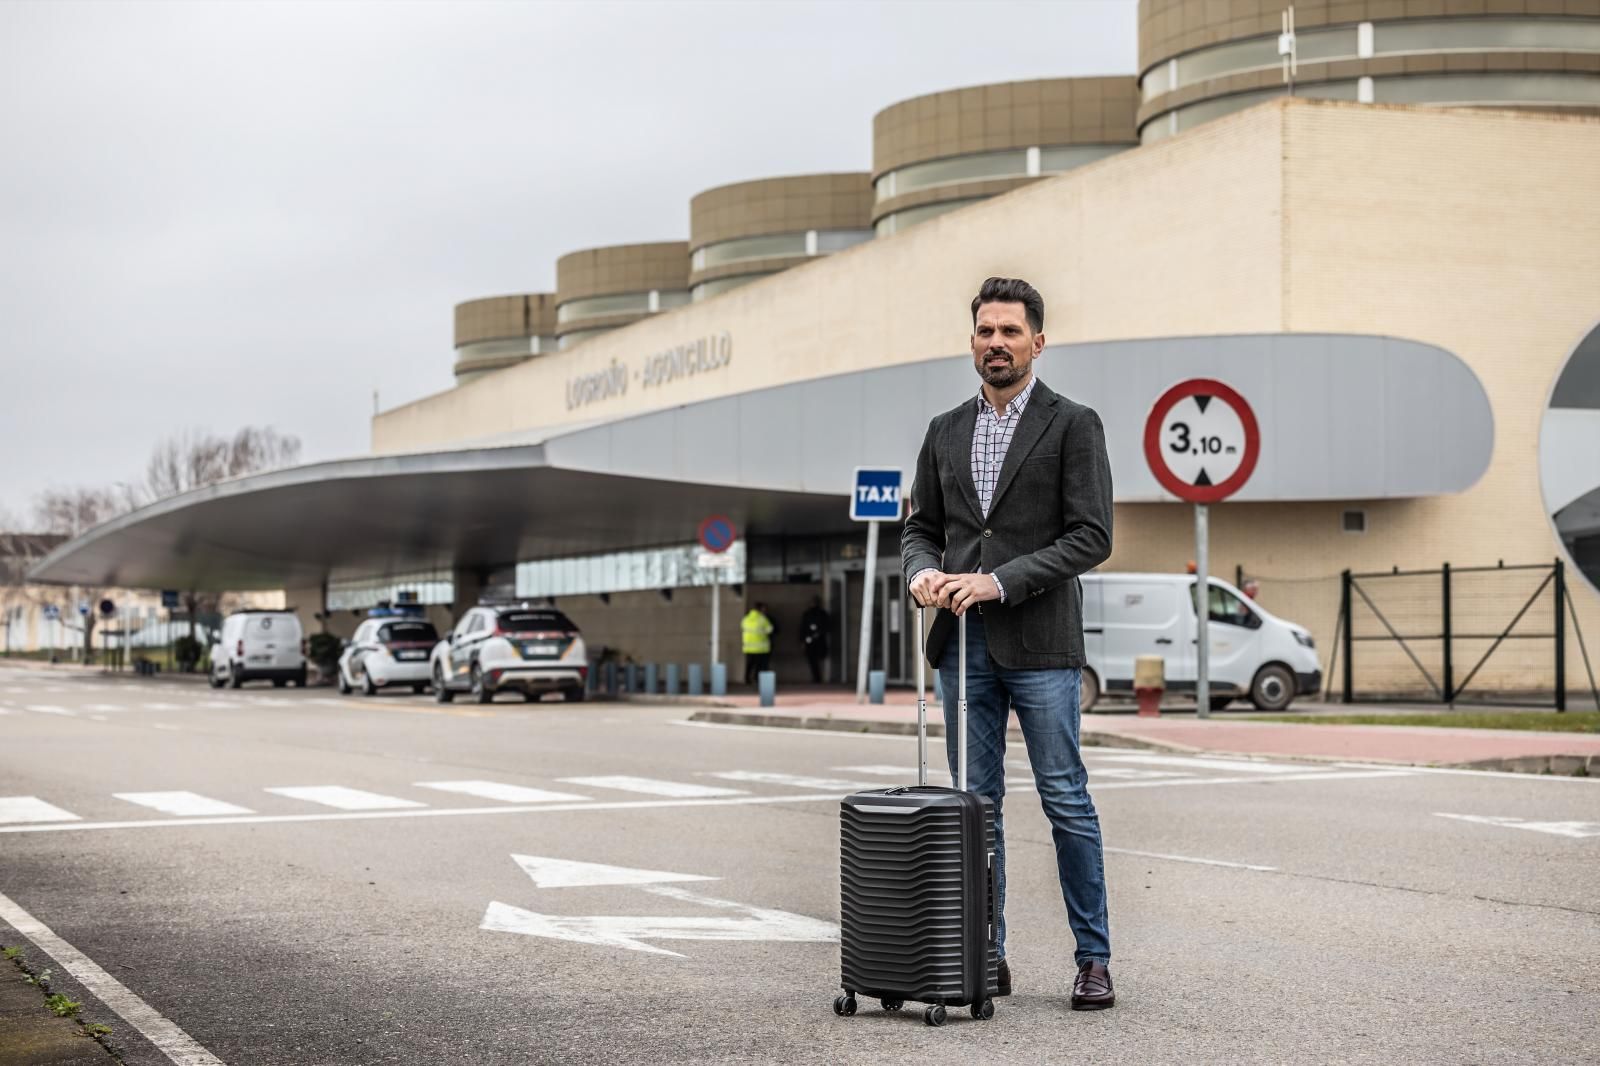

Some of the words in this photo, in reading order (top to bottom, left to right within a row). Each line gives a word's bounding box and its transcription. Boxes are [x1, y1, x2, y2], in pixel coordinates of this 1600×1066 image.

[565, 357, 628, 411] LOGROÑO
[642, 329, 732, 390] AGONCILLO
[1169, 421, 1222, 455] 3,10
[858, 485, 900, 503] TAXI
